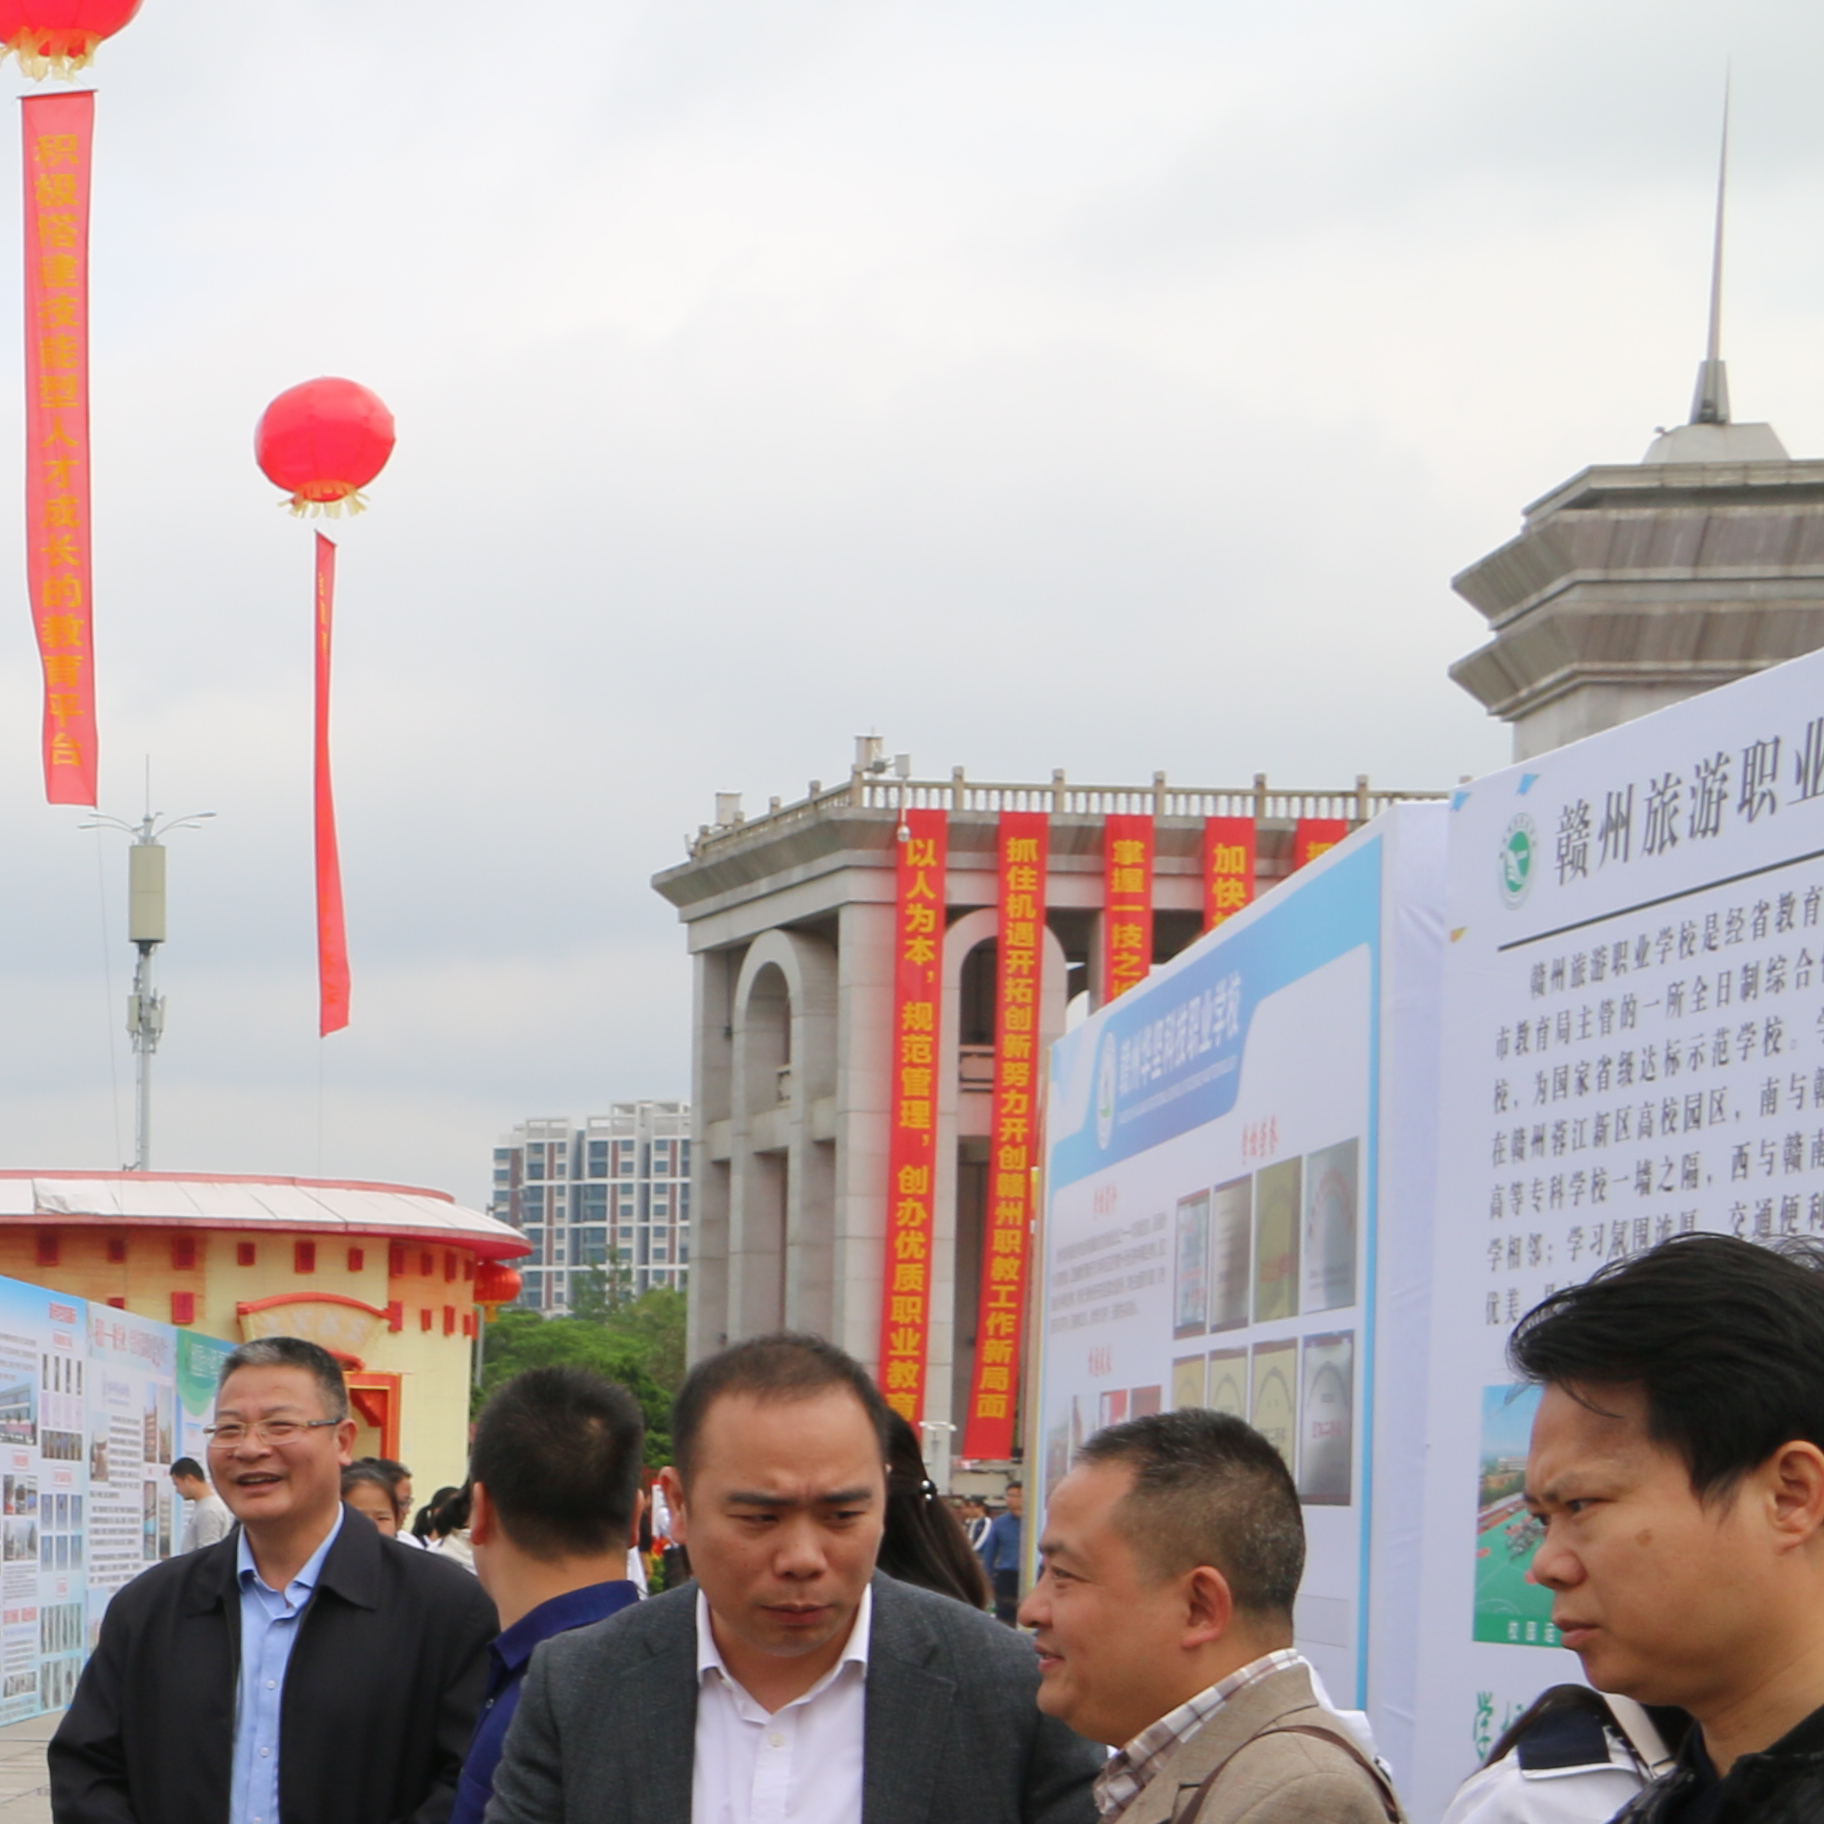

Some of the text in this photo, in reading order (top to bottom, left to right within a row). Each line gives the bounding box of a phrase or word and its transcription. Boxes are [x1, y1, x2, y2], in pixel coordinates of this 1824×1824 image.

[1495, 946, 1824, 1061] 市教育局主管的一所全日制综合
